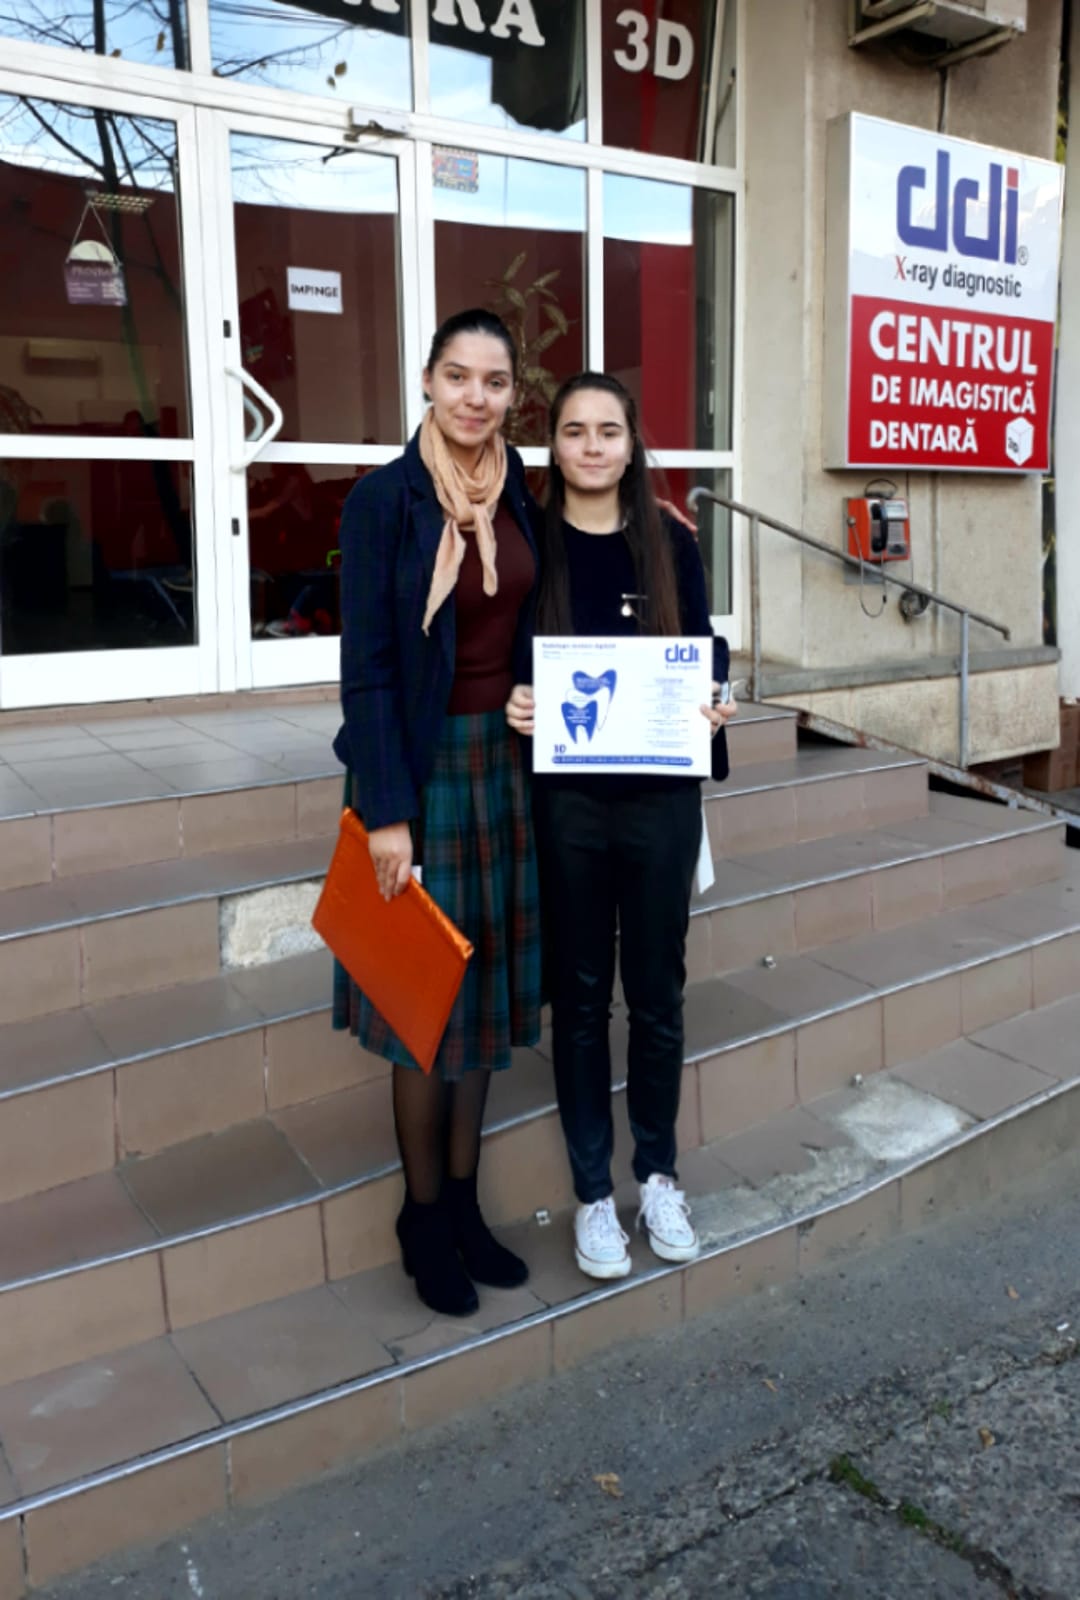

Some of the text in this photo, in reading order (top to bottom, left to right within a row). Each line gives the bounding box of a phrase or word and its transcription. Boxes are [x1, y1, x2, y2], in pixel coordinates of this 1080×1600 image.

[613, 9, 695, 80] 3D
[896, 149, 1019, 265] ddi
[291, 284, 338, 298] IMPINGE
[894, 255, 1022, 298] X-ray diagnostic
[869, 311, 1038, 375] CENTRUL
[871, 374, 1037, 415] DE IMAGISTICĂ
[870, 418, 979, 454] DENTARĂ
[665, 643, 700, 662] ddi
